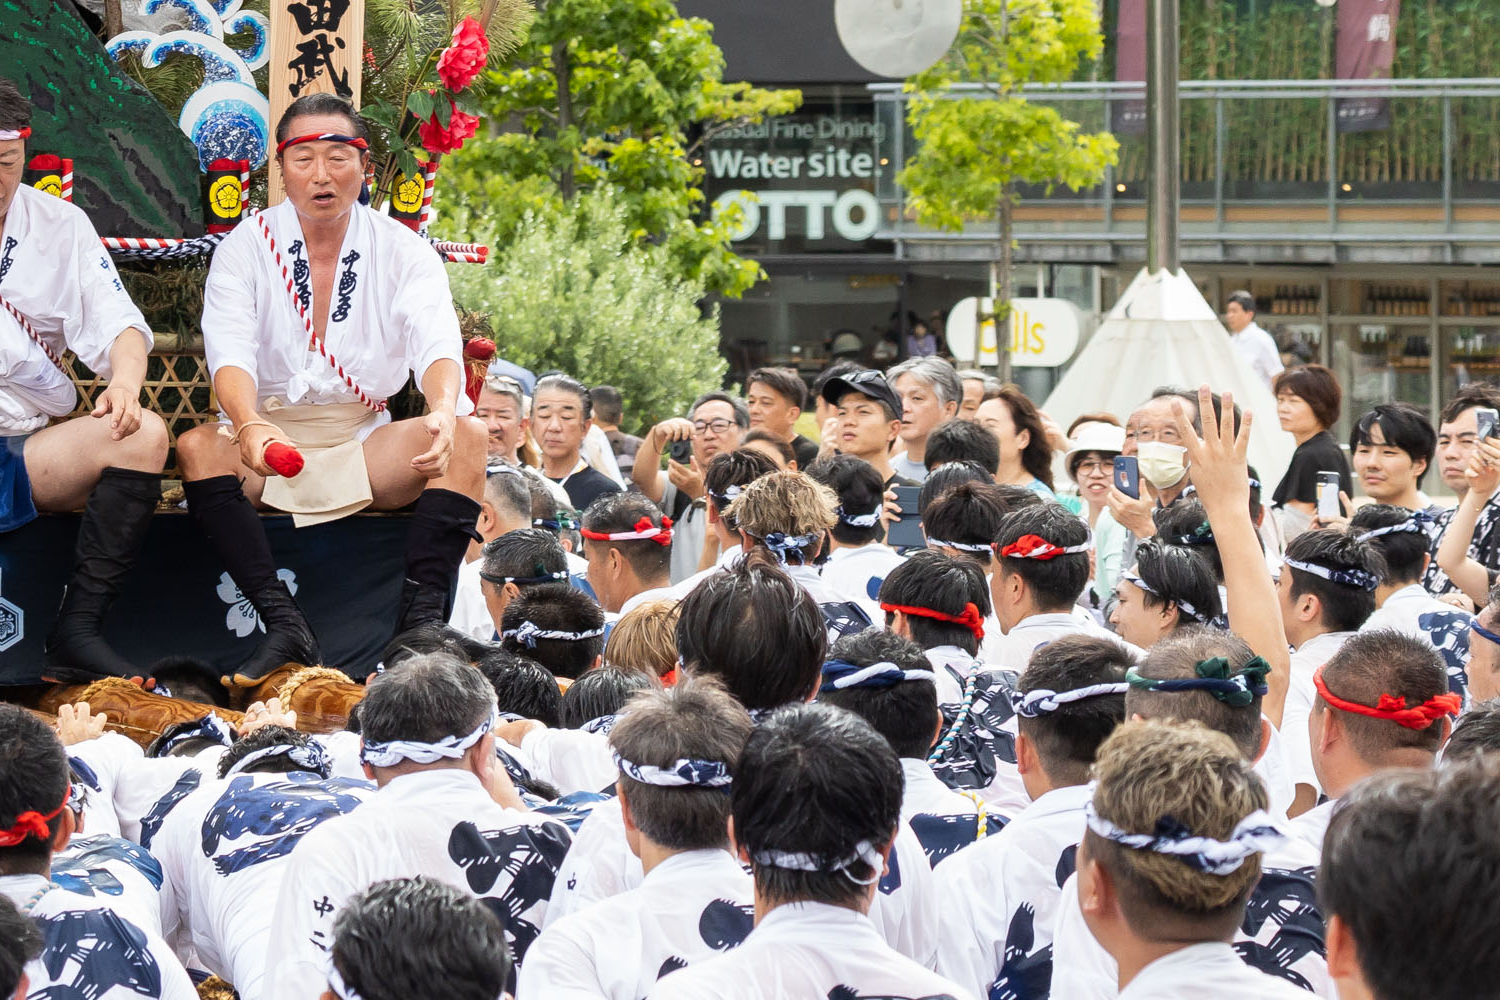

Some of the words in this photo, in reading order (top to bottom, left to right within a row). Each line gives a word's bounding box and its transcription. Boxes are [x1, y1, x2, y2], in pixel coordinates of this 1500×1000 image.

[703, 117, 769, 139] asual
[772, 120, 814, 139] Fine
[818, 118, 886, 144] Dining
[710, 149, 804, 179] Water
[711, 188, 881, 241] OTTO
